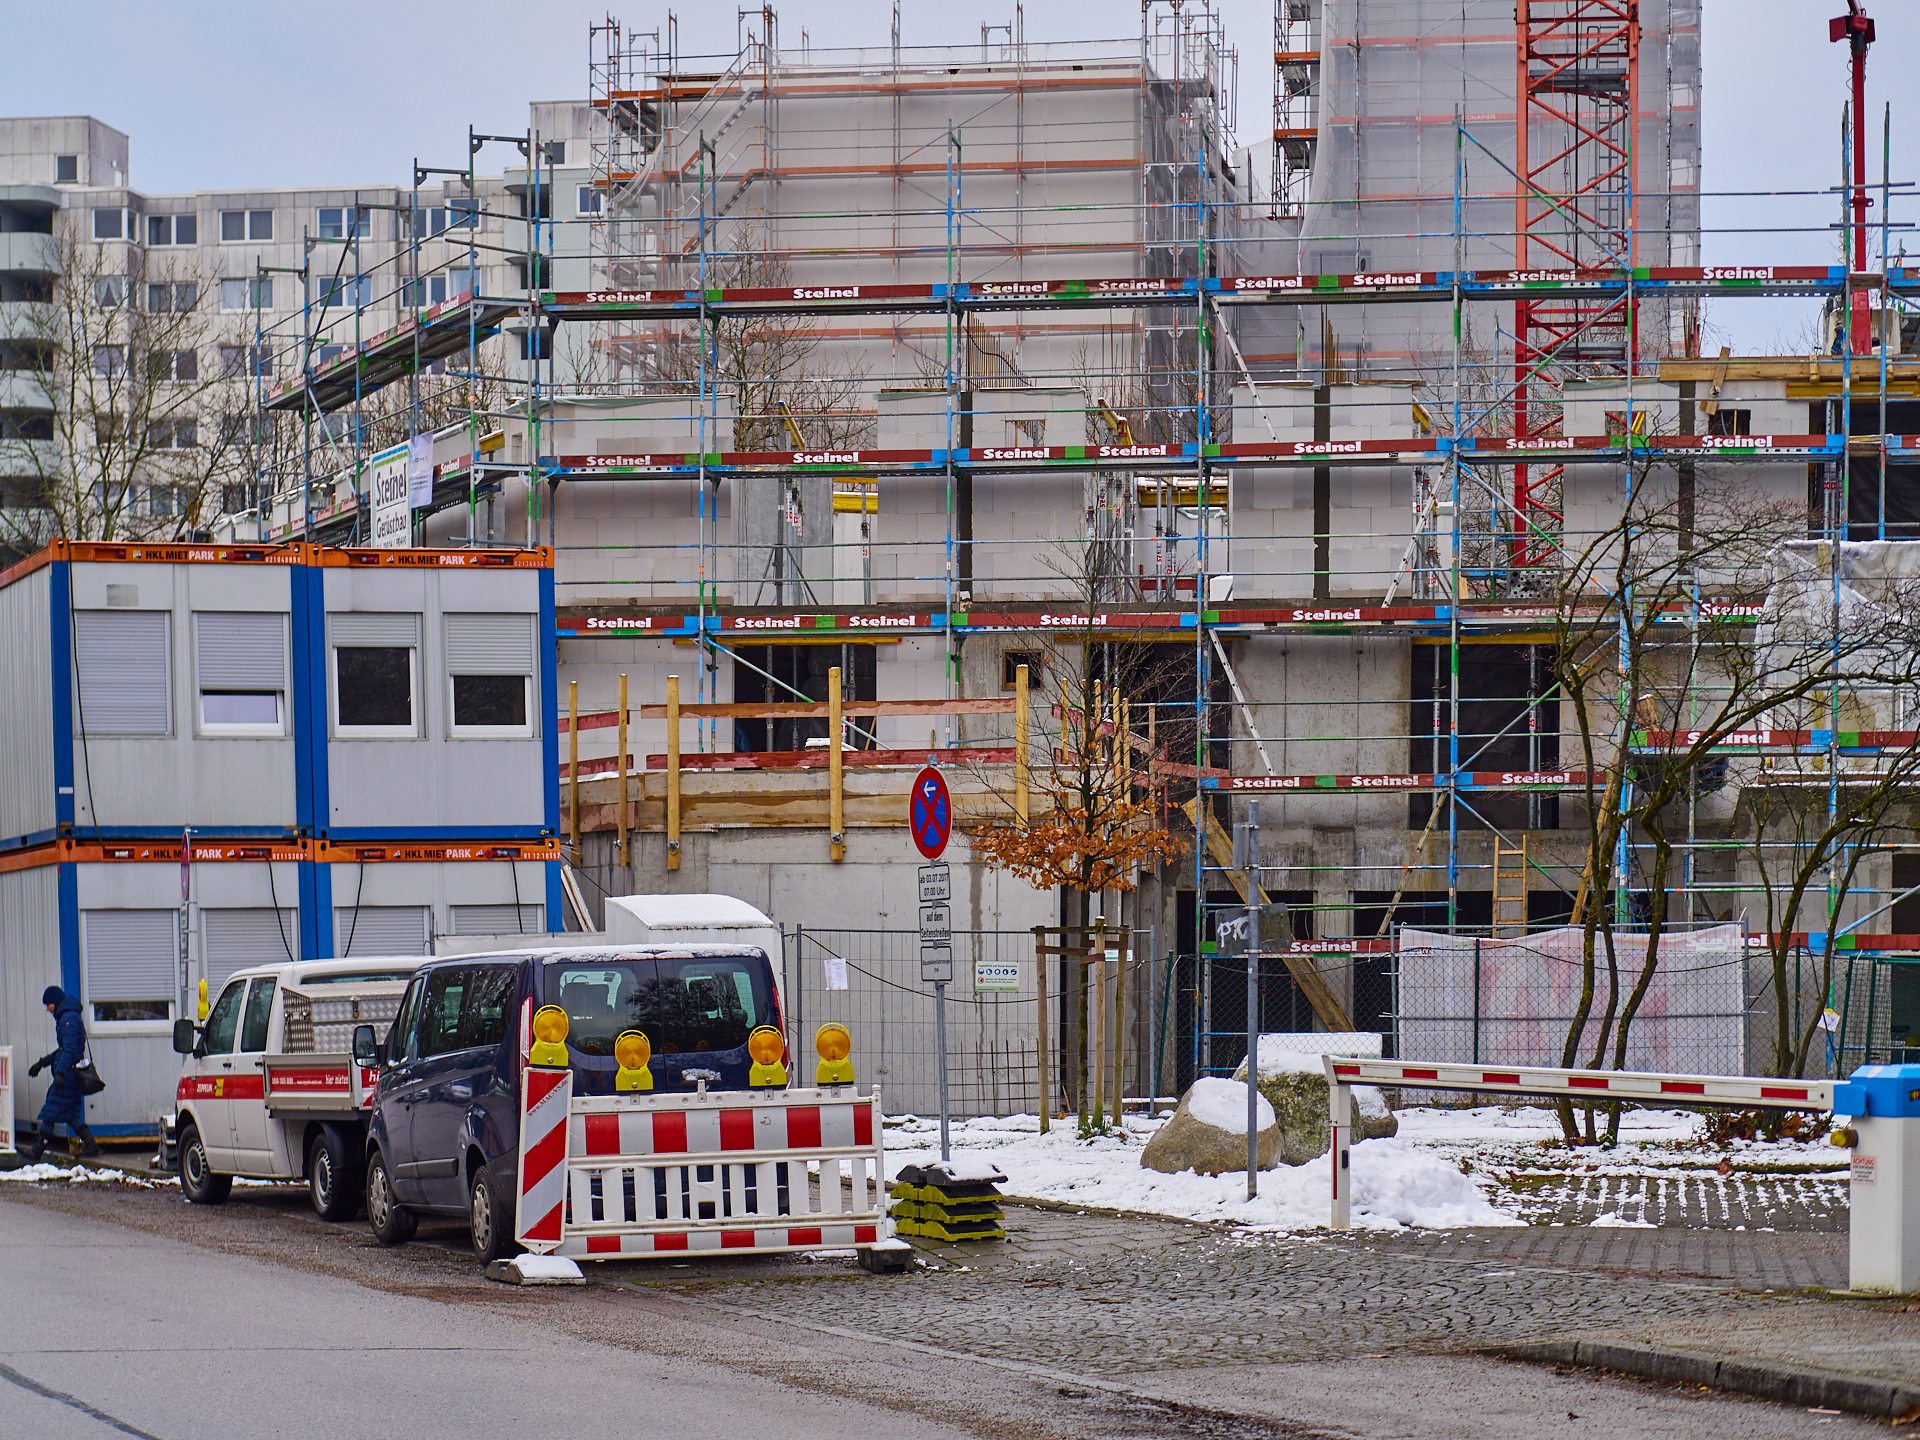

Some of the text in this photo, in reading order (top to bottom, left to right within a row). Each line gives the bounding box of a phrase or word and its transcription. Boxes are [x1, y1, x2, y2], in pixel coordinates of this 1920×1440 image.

[1703, 266, 1774, 279] Steinel
[1098, 278, 1166, 291] Steinel
[1234, 276, 1303, 289] Steinel
[1353, 273, 1422, 286] Steinel
[793, 286, 859, 299] Steinel
[982, 281, 1048, 294] Steinel
[586, 291, 652, 303] Steinel
[1293, 440, 1362, 454] Steinel
[1505, 437, 1575, 449] Steinel
[1701, 434, 1773, 448] Steinel
[793, 450, 859, 464] Steinel
[983, 447, 1050, 460] Steinel
[1099, 444, 1167, 457] Steinel
[586, 455, 651, 467] Steinel
[376, 462, 407, 507] Steinel
[376, 511, 407, 539] Gerüstbau
[145, 550, 164, 560] HKL
[165, 550, 214, 560] MIETPARK
[398, 555, 465, 565] HKL MIETPARK
[1292, 608, 1361, 621] Steinel
[1700, 603, 1764, 616] Steine
[586, 617, 652, 629] Steinel
[734, 616, 801, 629] Steinel
[849, 615, 916, 627] Steinel
[1040, 614, 1108, 626] Steinel
[1687, 730, 1771, 745] Sinel
[1232, 777, 1300, 788] Steinel
[1351, 775, 1419, 787] Steinel
[1501, 772, 1571, 784] Steinel
[153, 849, 172, 859] HKL
[173, 849, 222, 859] MTPARK
[405, 850, 423, 859] HKL
[424, 849, 471, 859] MIETPARK
[934, 911, 943, 922] dem
[1290, 941, 1358, 952] Steinel
